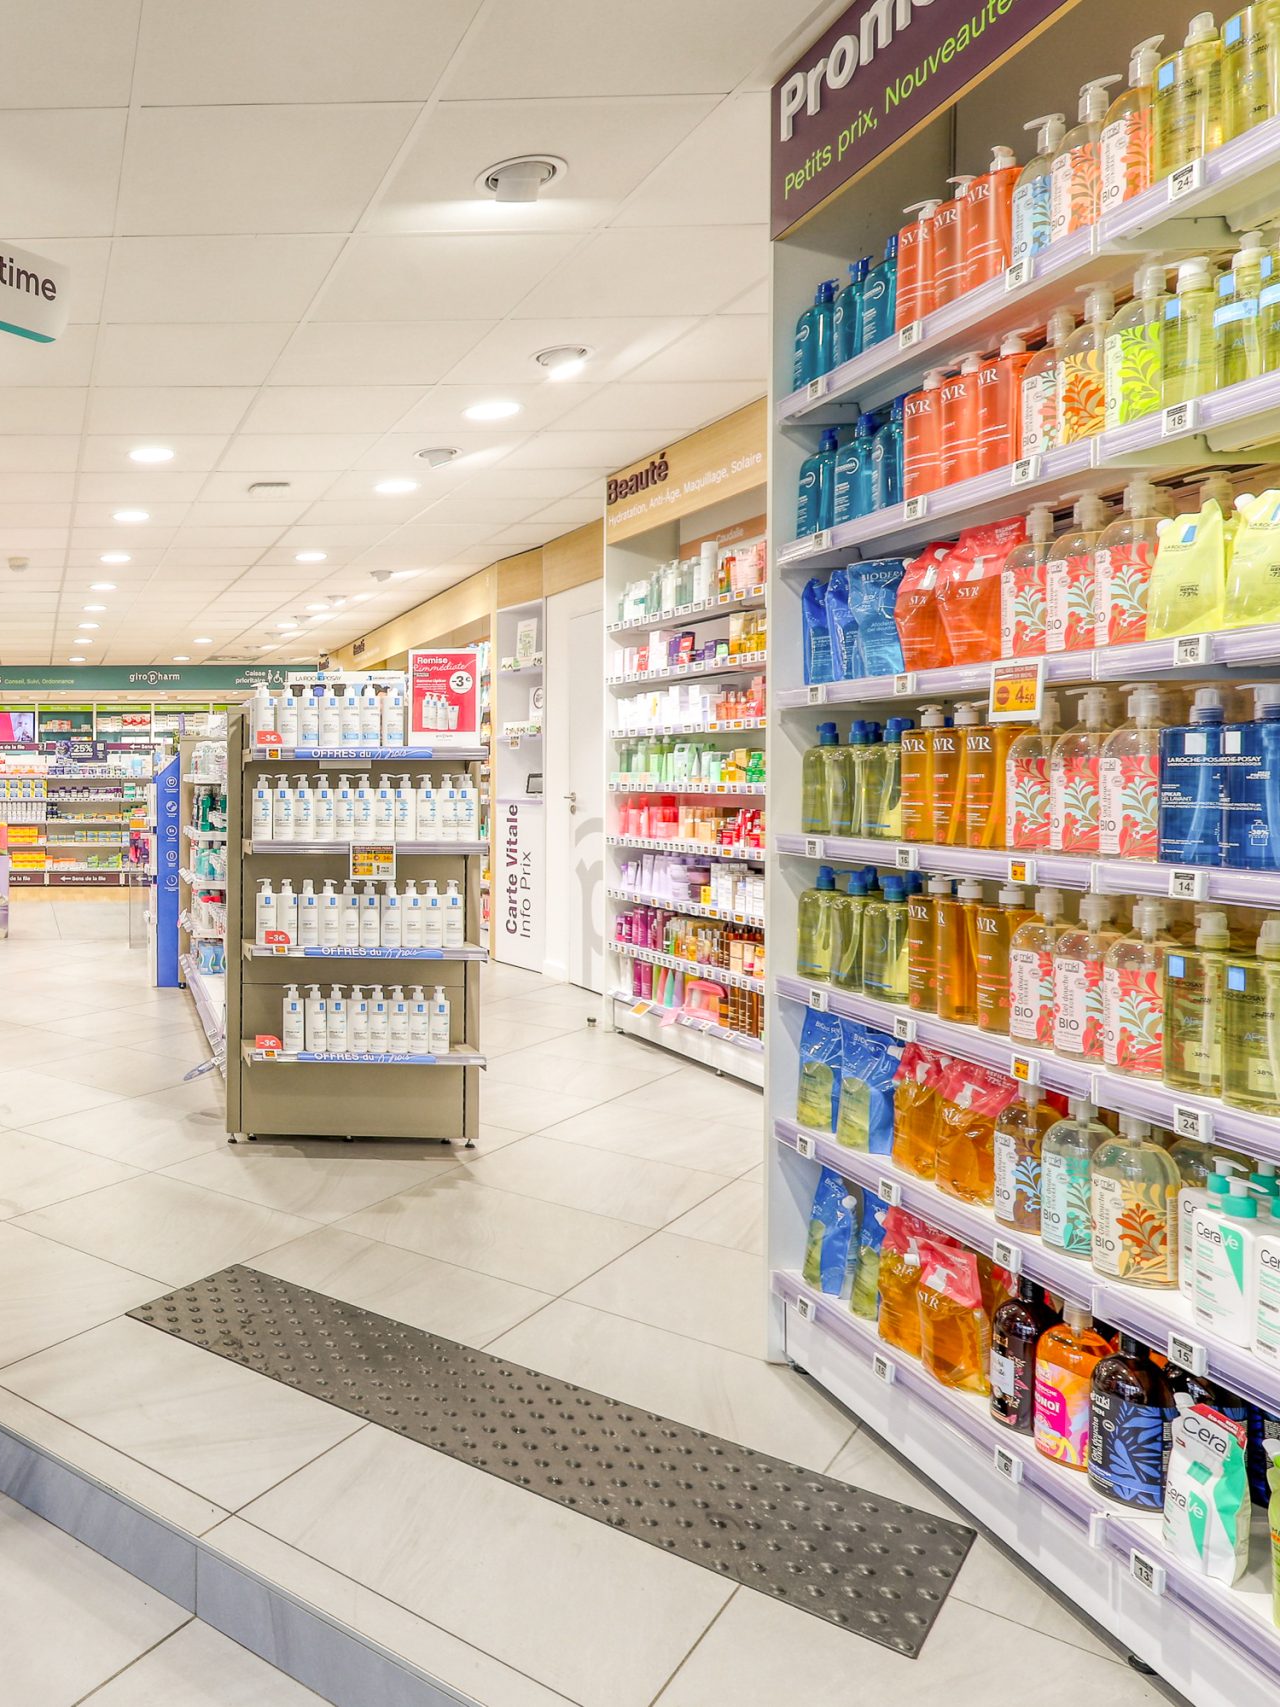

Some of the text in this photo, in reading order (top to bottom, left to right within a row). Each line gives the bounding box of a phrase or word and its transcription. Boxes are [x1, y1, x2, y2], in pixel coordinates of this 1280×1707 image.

[780, 0, 936, 142] Prom
[785, 143, 832, 201] Petits
[837, 106, 879, 162] prix,
[1103, 185, 1120, 202] BIO
[900, 226, 930, 248] SVR
[1014, 241, 1028, 258] BIO
[942, 383, 967, 402] SVR
[905, 398, 931, 418] SVR
[607, 452, 669, 506] Beauté
[609, 501, 648, 527] Hydratation,
[683, 468, 729, 494] Maquillage,
[730, 452, 762, 475] Solaire
[956, 586, 981, 598] SVR
[1047, 619, 1062, 631] BIO
[4, 678, 26, 686] Conseil,
[26, 678, 41, 686] Suivi,
[129, 671, 180, 685] giropharm
[71, 743, 93, 753] -25%
[311, 749, 356, 758] OFFRES
[359, 749, 371, 758] du
[1100, 820, 1116, 832] BIO
[505, 804, 519, 935] Carte Vitale
[520, 851, 532, 938] Info Prix
[321, 946, 366, 956] OFFRES
[370, 947, 382, 956] du
[1014, 1006, 1033, 1018] BIO
[1059, 1018, 1079, 1030] BIO
[314, 1052, 360, 1061] OFFRES
[362, 1052, 375, 1062] du
[995, 1186, 1010, 1200] BIO
[1044, 1209, 1061, 1224] BIO
[1096, 1191, 1105, 1235] Gel douche
[1095, 1235, 1115, 1251] BIO
[1196, 1221, 1240, 1250] CeraVe
[1091, 1416, 1099, 1449] douche
